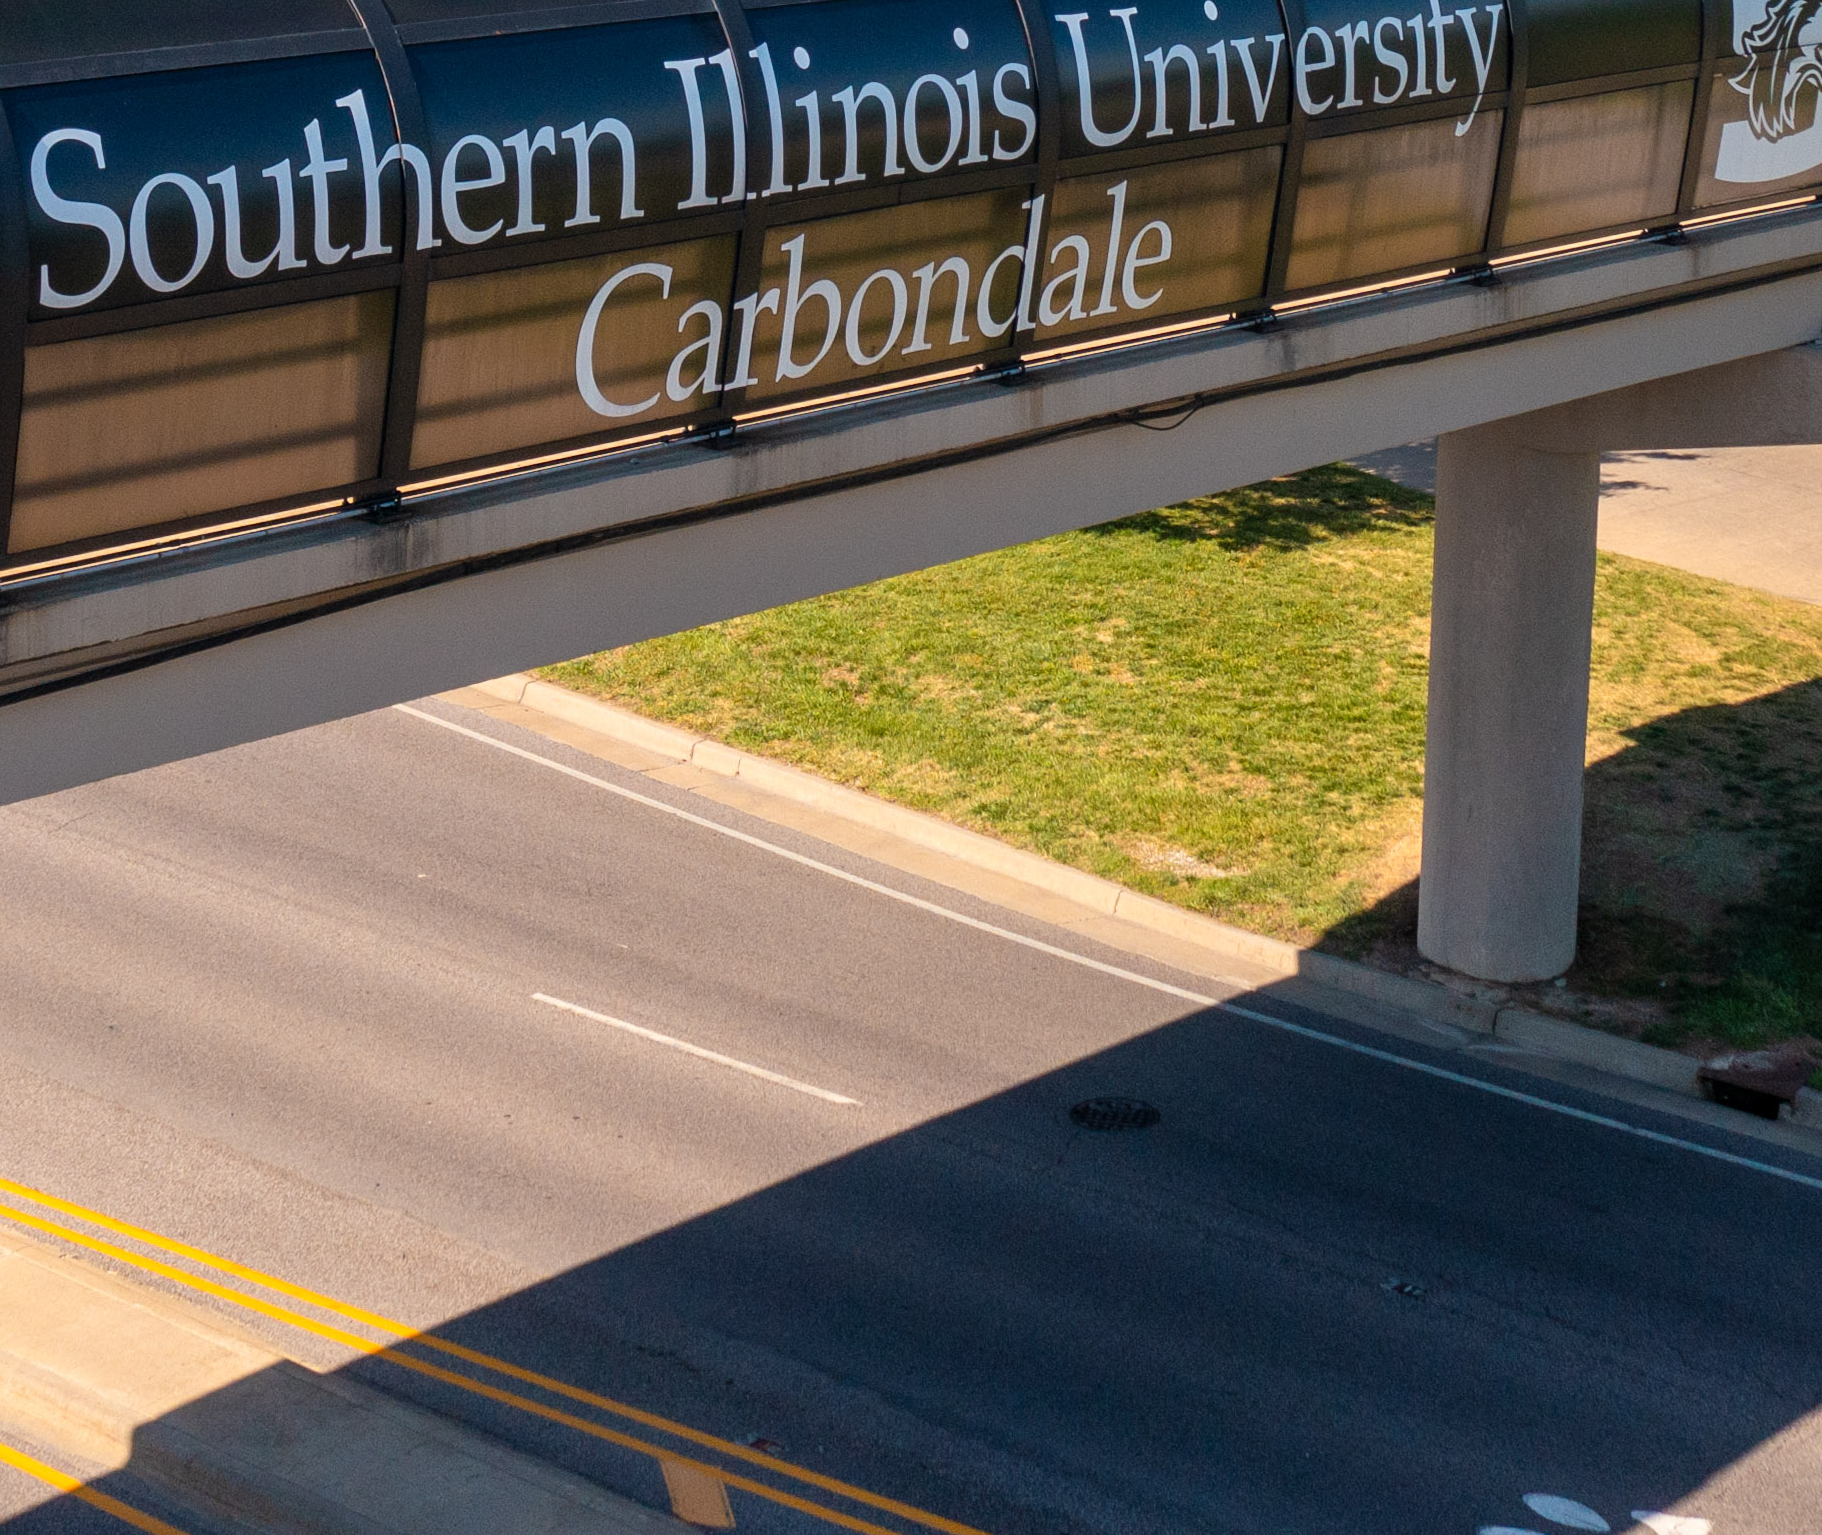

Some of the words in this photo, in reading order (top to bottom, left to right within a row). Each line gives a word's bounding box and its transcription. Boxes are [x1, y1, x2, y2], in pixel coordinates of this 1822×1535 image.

[30, 88, 644, 308] Southern
[664, 27, 1036, 210] Illinois
[575, 179, 1173, 418] Carbondale
